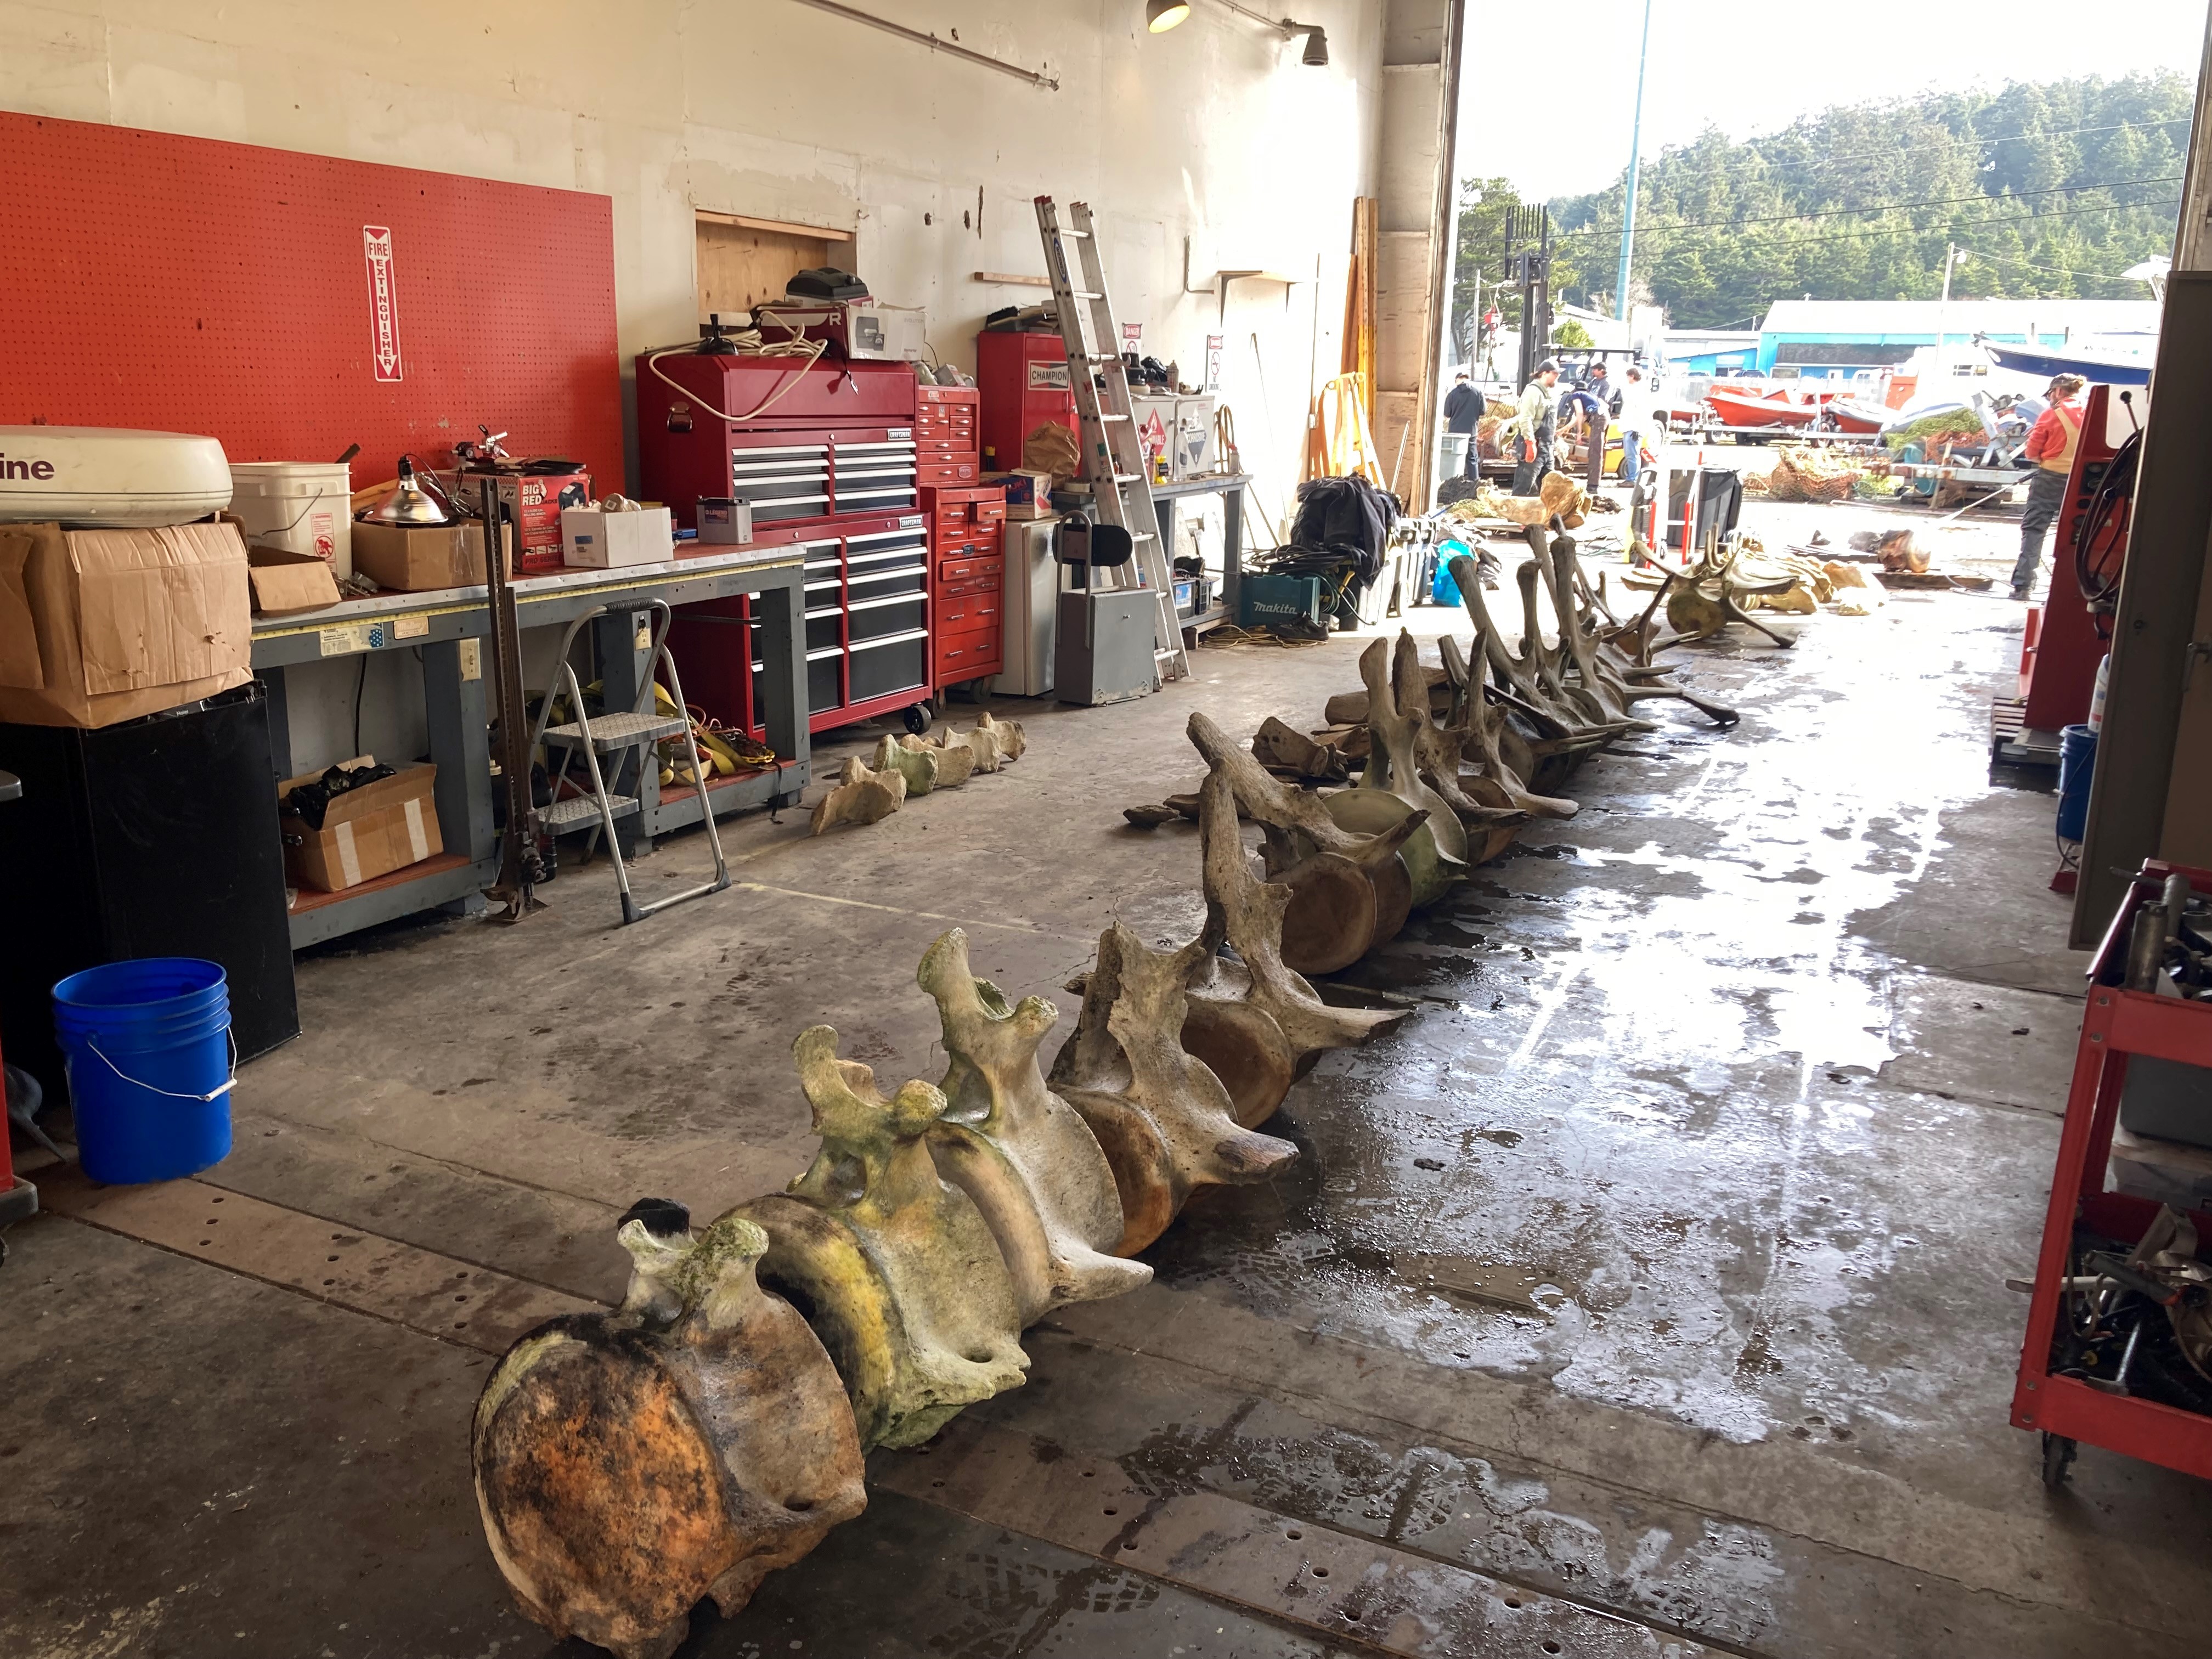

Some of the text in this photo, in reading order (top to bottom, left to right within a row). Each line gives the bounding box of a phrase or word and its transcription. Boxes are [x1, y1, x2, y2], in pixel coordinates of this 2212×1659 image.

[369, 242, 388, 256] FIRE
[1056, 246, 1065, 275] WERNER
[376, 259, 392, 366] EXTINGUISHER
[1125, 327, 1139, 335] DANGER
[1032, 370, 1067, 381] CHAMPION
[1188, 431, 1205, 444] CORROSIVE
[0, 453, 55, 480] ine
[523, 484, 540, 495] BIG
[522, 494, 542, 506] RED
[901, 518, 922, 527] CRAFTSMAN
